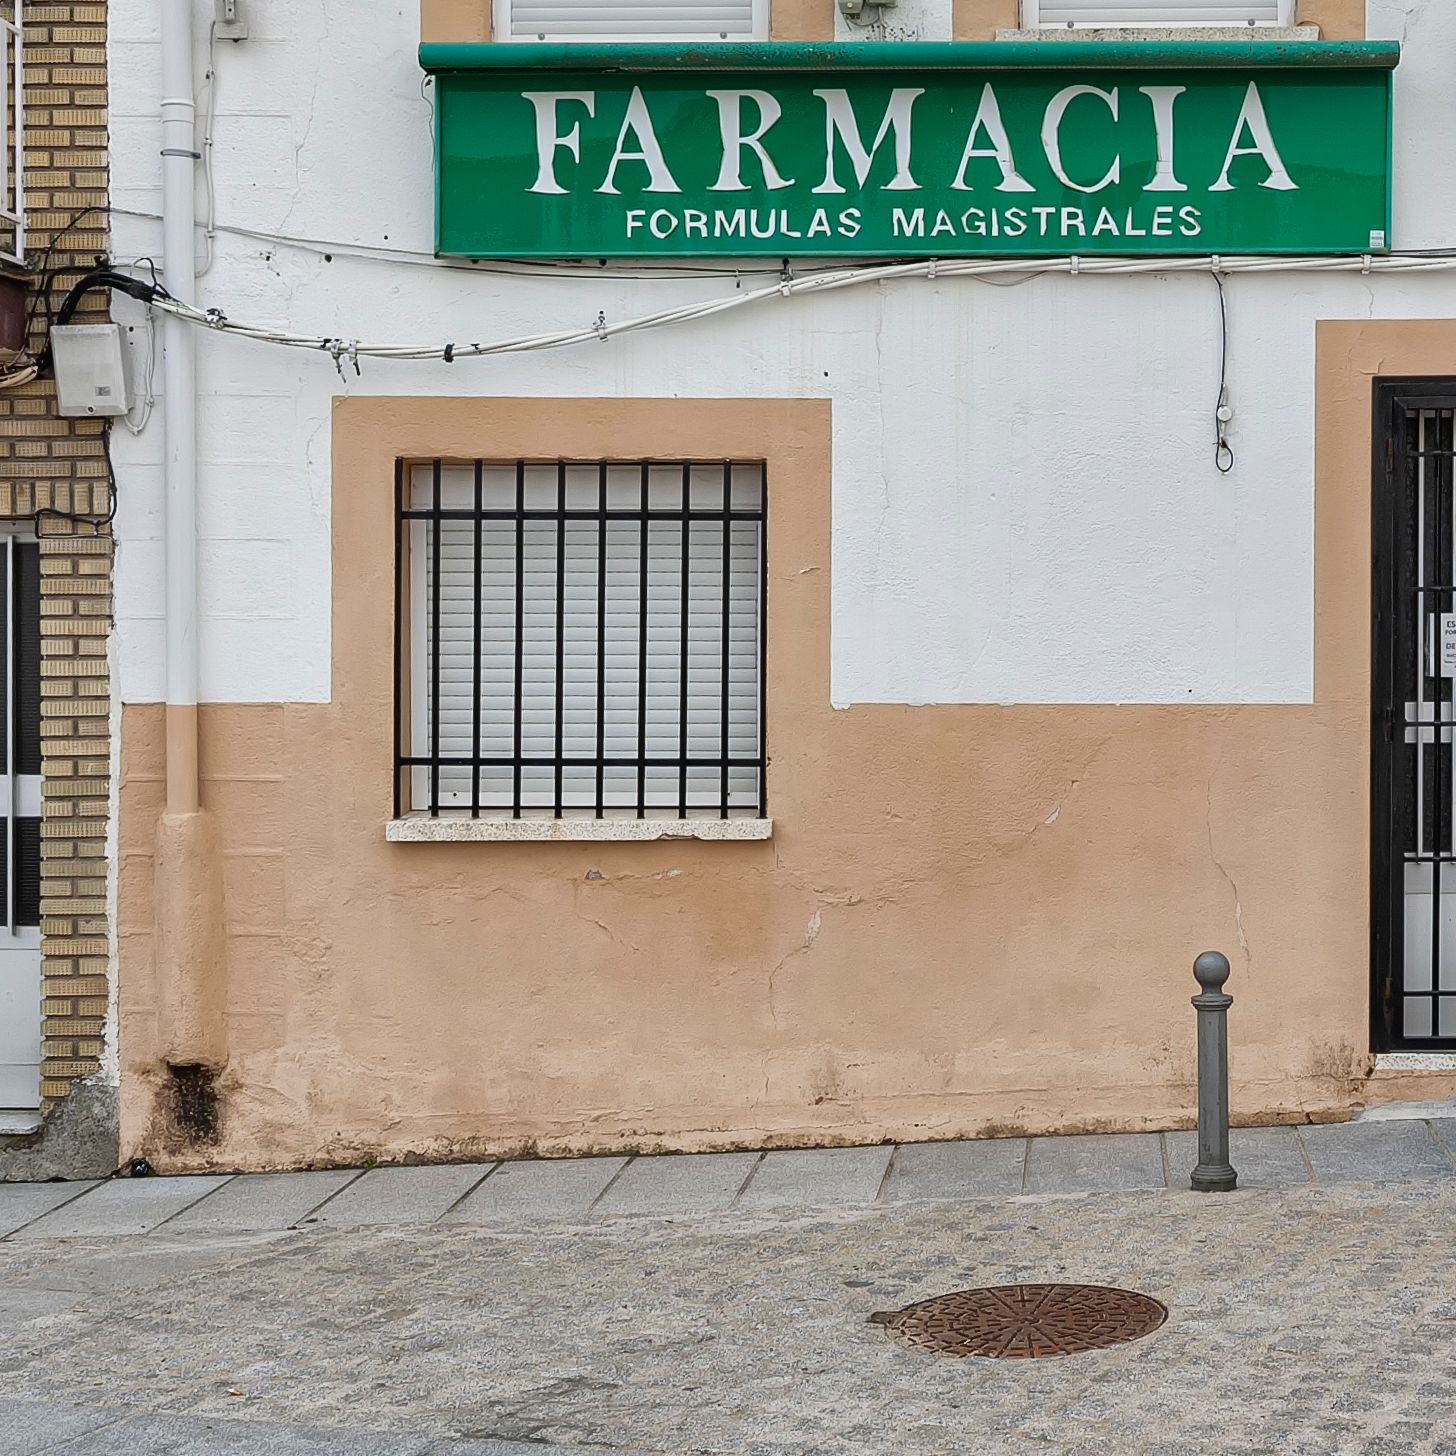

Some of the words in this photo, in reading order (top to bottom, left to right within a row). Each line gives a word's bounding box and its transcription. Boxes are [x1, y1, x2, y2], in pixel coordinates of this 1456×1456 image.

[521, 82, 1300, 195] FARMACIA
[626, 208, 862, 239] FORMULAS
[892, 206, 1201, 238] MAGISTRALES
[1446, 642, 1456, 650] DE
